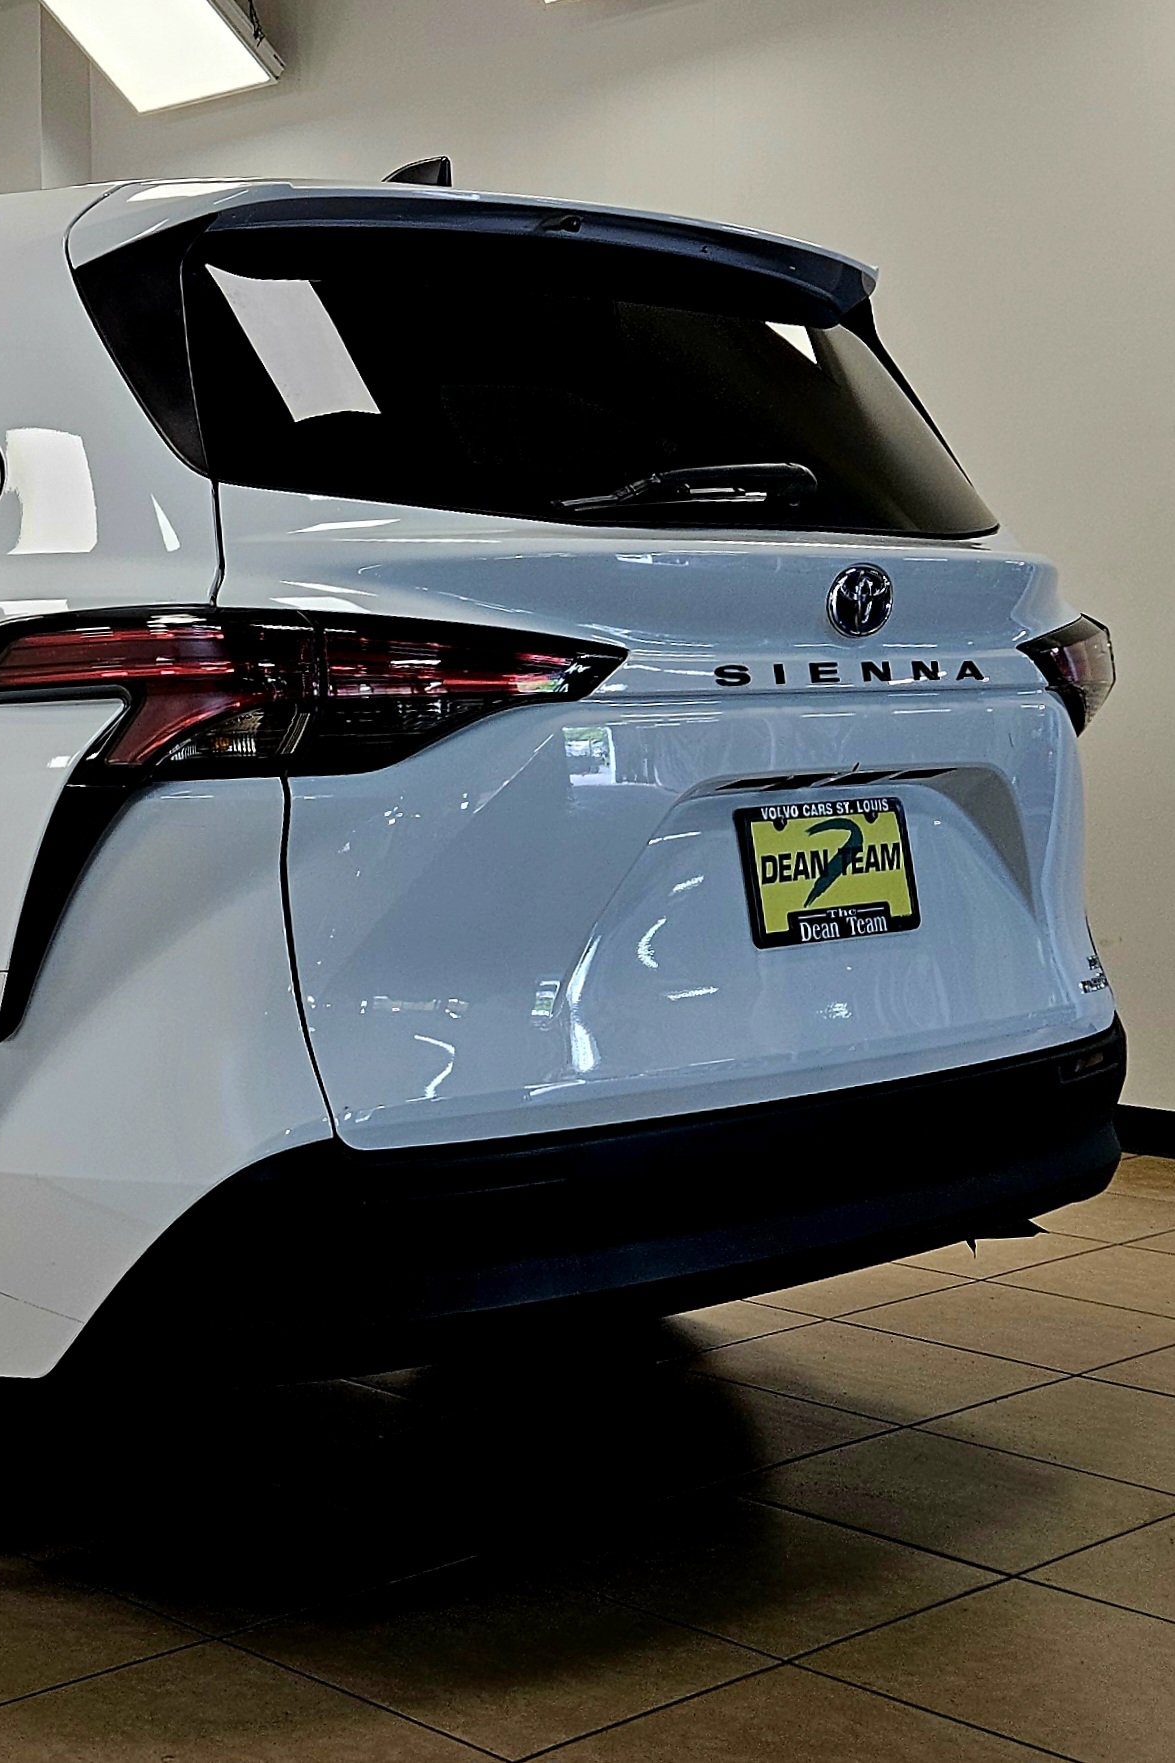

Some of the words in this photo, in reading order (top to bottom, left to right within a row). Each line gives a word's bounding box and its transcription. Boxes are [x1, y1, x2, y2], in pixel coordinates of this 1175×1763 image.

[714, 660, 985, 687] SIENNA
[761, 805, 799, 820] VOLVO
[803, 802, 833, 817] CARS
[836, 801, 854, 814] ST.
[857, 798, 889, 813] LOUIS
[760, 848, 829, 885] DEAN
[837, 842, 902, 876] TEAM
[826, 907, 857, 918] The
[799, 921, 840, 942] Dean
[845, 915, 888, 936] Team
